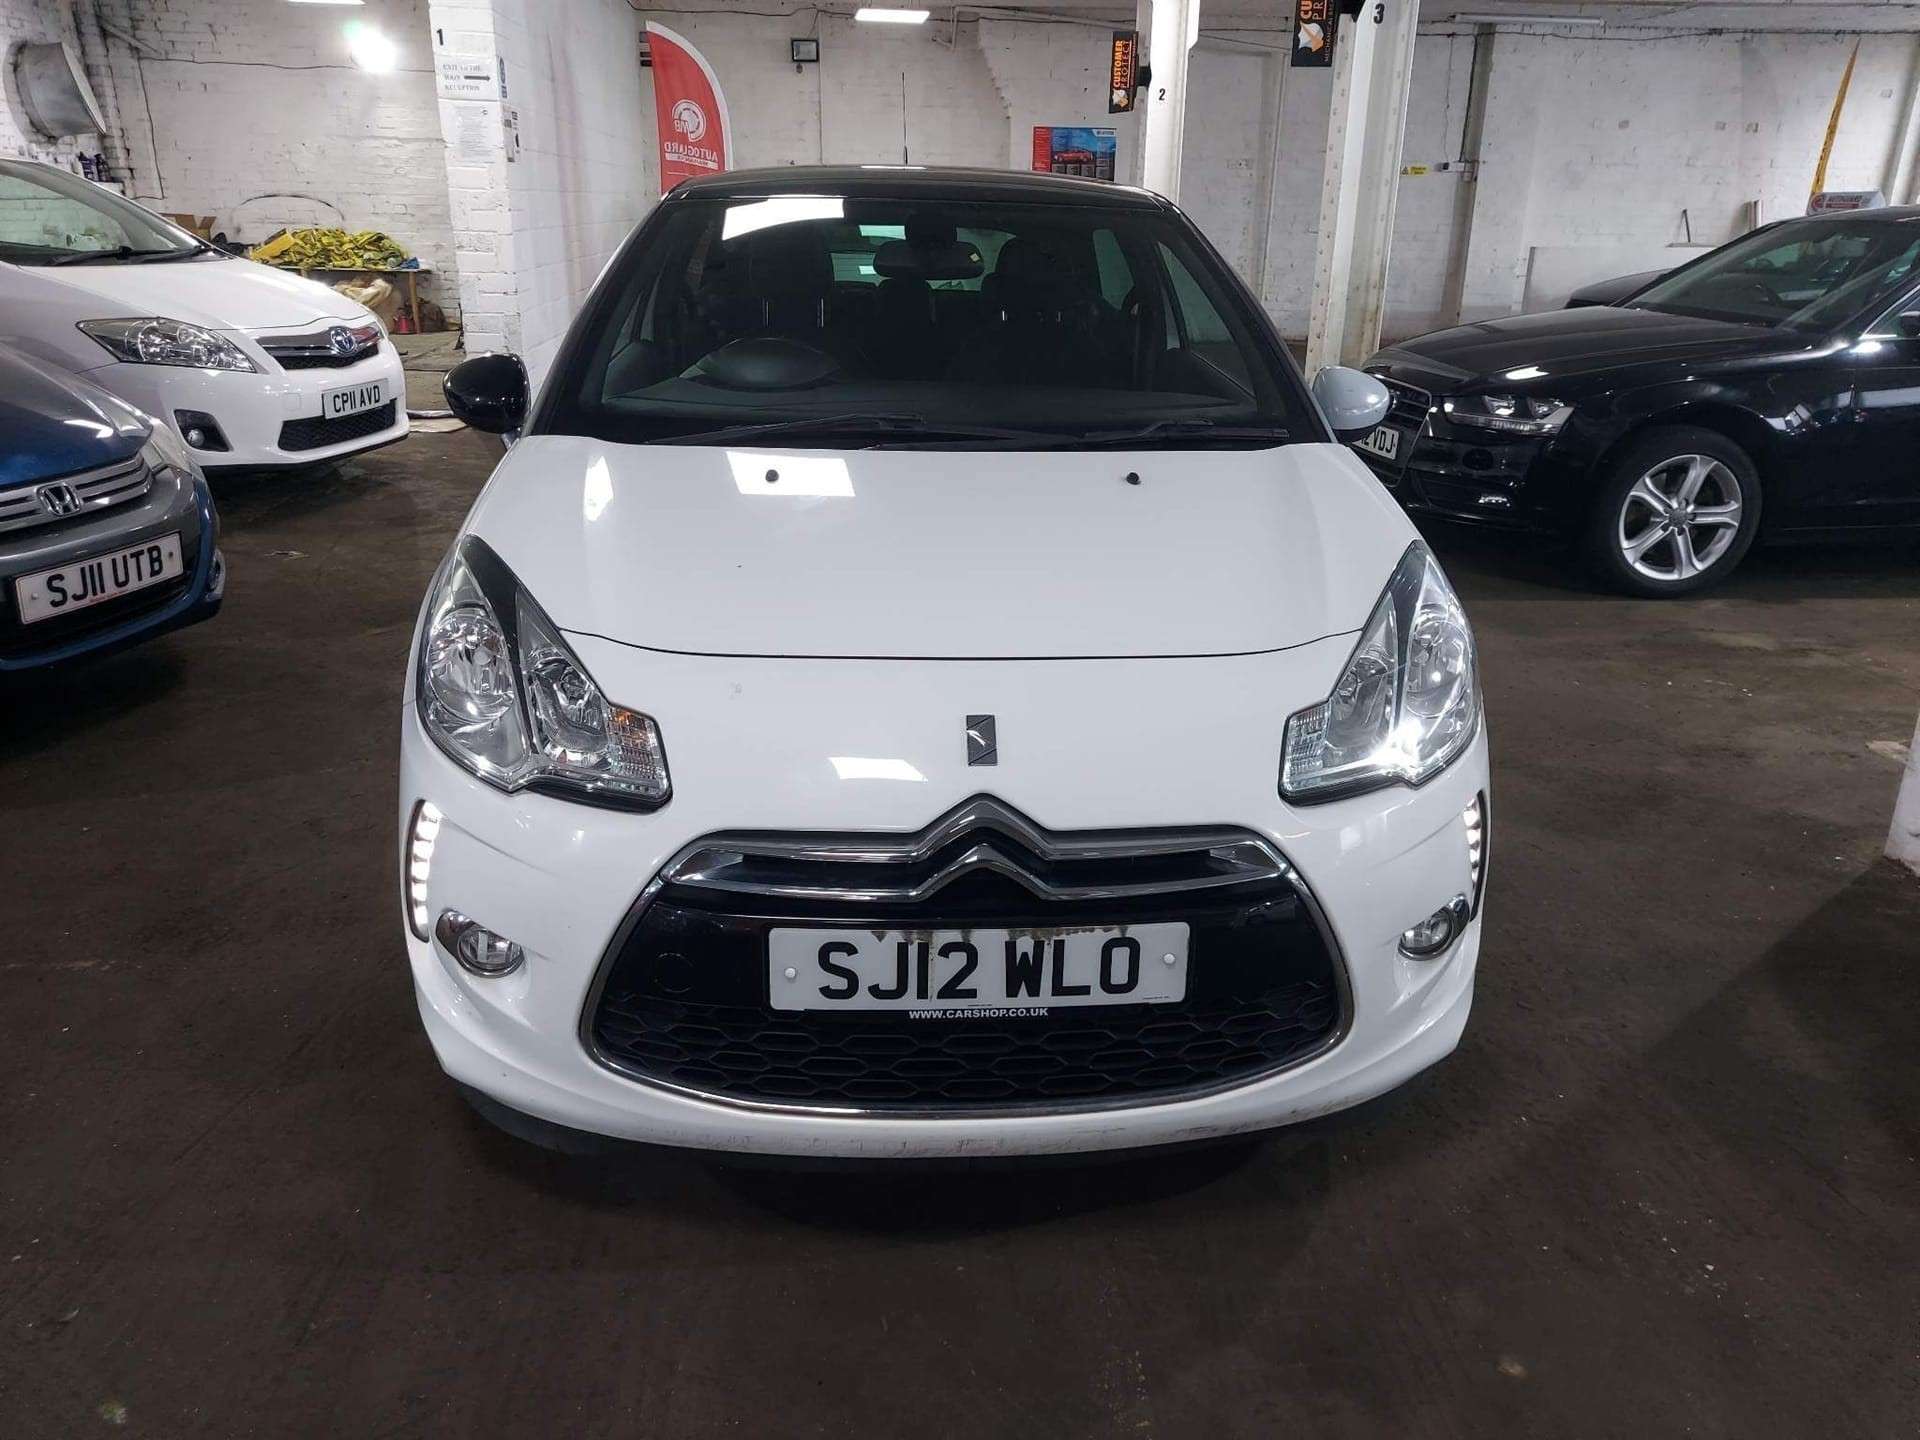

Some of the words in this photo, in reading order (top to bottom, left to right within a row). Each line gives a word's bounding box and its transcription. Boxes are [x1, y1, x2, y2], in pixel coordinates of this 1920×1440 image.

[1373, 3, 1385, 25] 3
[437, 28, 444, 46] 1
[1113, 40, 1123, 88] CUSTOMER
[1120, 40, 1130, 88] PROTECT
[1158, 88, 1166, 101] 2
[333, 391, 356, 413] CP11
[359, 384, 381, 408] AVD
[46, 562, 106, 607] SJ11
[111, 545, 163, 588] UTB
[817, 941, 979, 1001] SJ12
[1004, 937, 1141, 999] WLO
[909, 1006, 1049, 1020] WWW.CARSHOP.CO.UK
